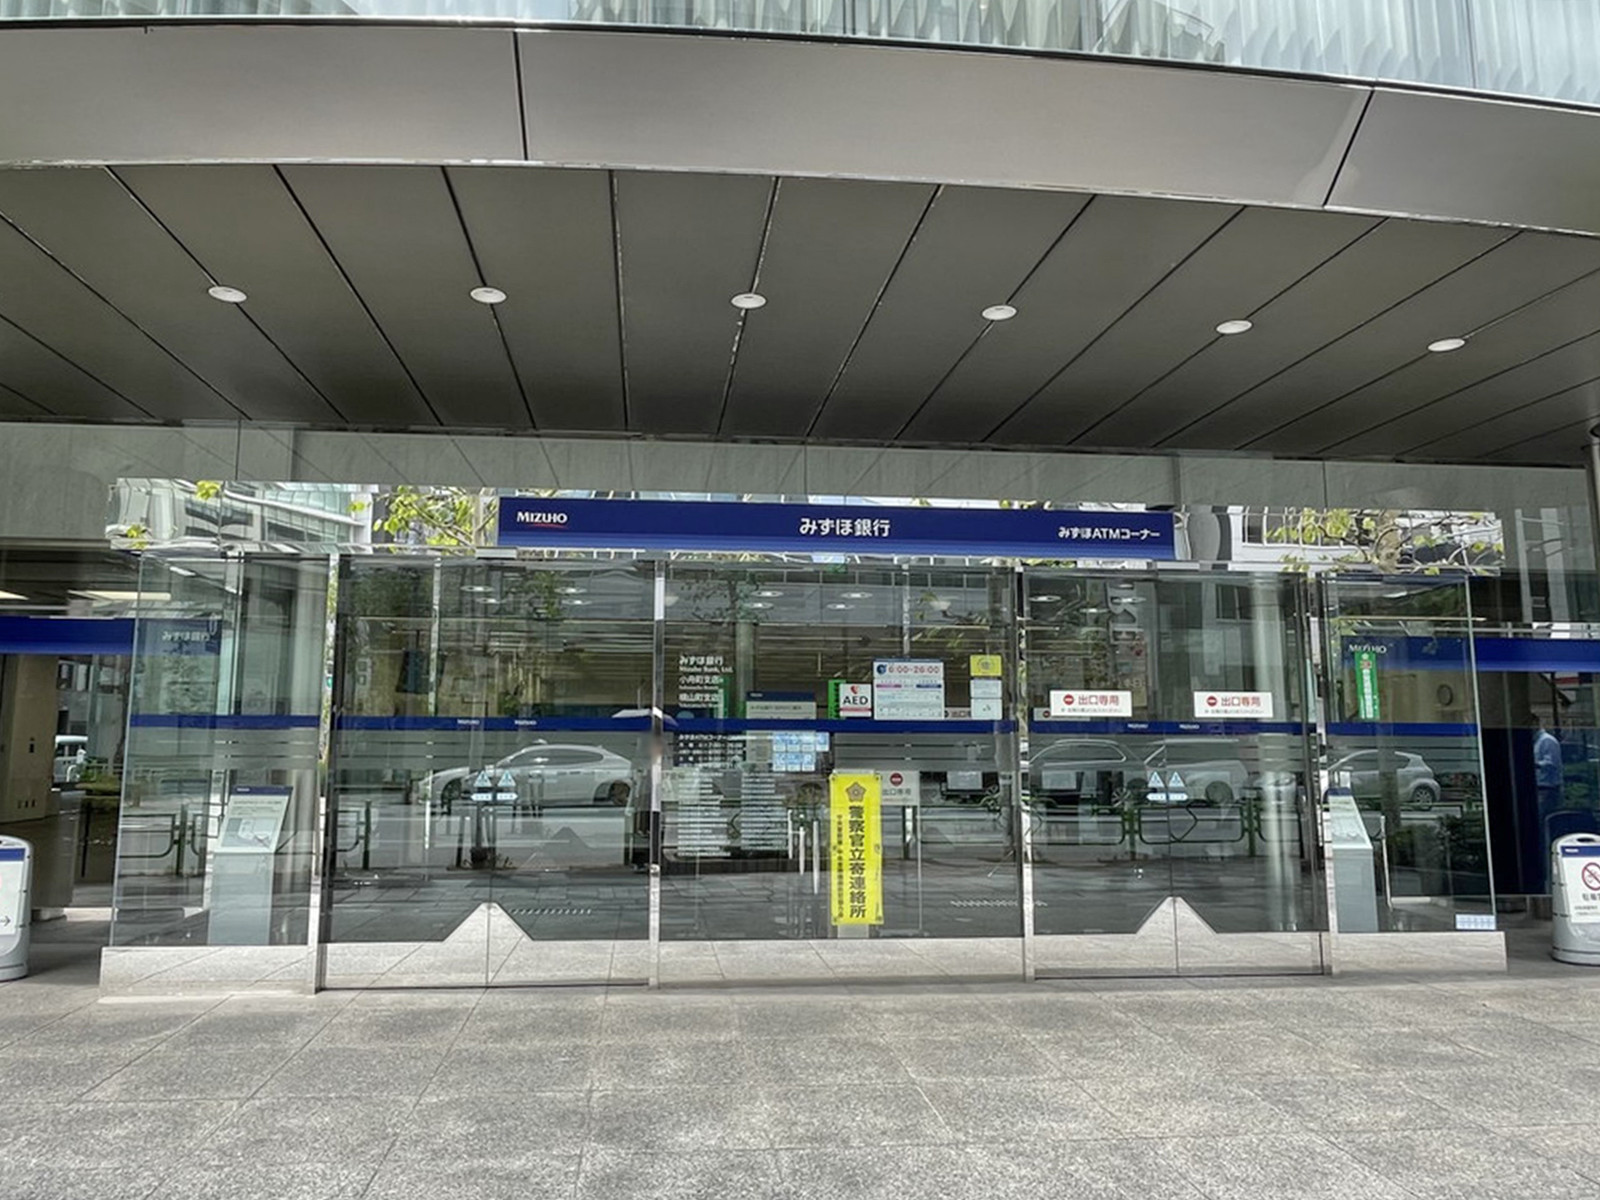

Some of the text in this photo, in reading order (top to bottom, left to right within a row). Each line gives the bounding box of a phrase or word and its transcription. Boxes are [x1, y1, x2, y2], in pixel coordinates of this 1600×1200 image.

[516, 511, 568, 524] MIZUHO
[799, 517, 891, 537] みずほ銀行
[1058, 526, 1161, 540] みずほATMコーナー
[843, 695, 869, 706] AED
[1078, 694, 1120, 706] 出口専用
[1221, 696, 1262, 707] 出口専用
[848, 805, 867, 918] 警察官立寄連絡所
